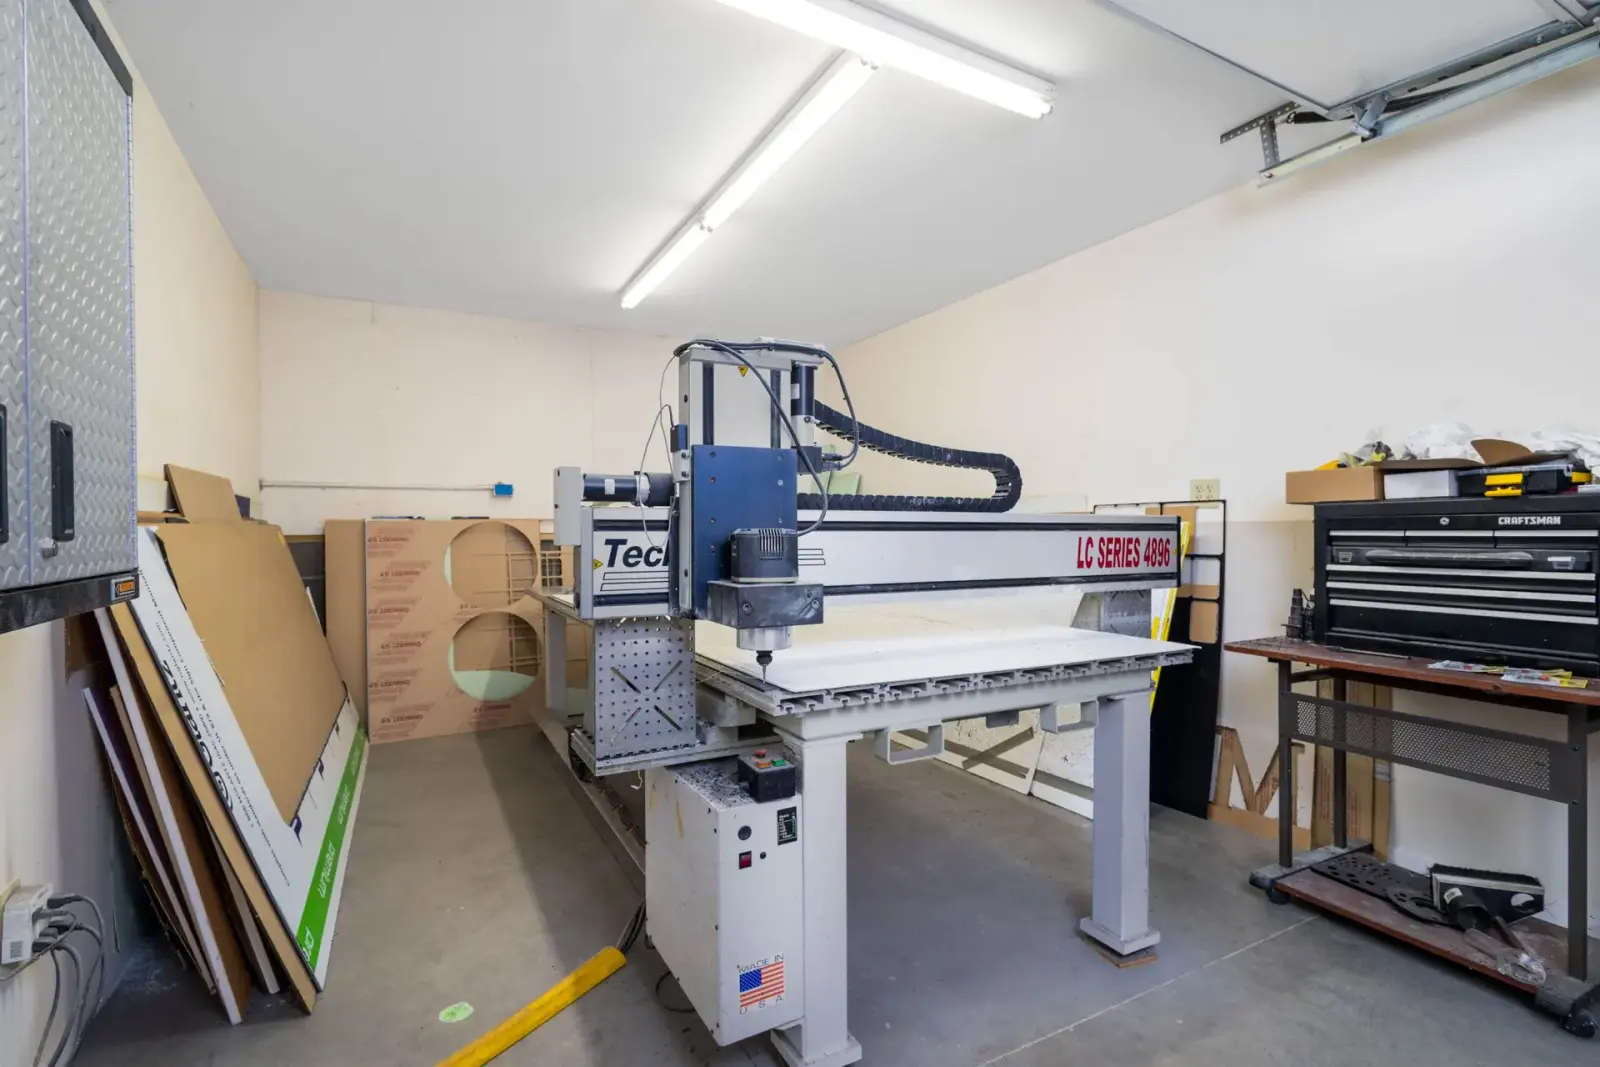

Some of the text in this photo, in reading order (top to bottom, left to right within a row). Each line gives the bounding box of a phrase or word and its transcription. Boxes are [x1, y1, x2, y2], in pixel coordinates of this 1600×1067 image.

[1498, 516, 1561, 525] CRAFTSMAN
[1077, 536, 1170, 569] LC SERIES 4896
[739, 953, 785, 973] MADE IN
